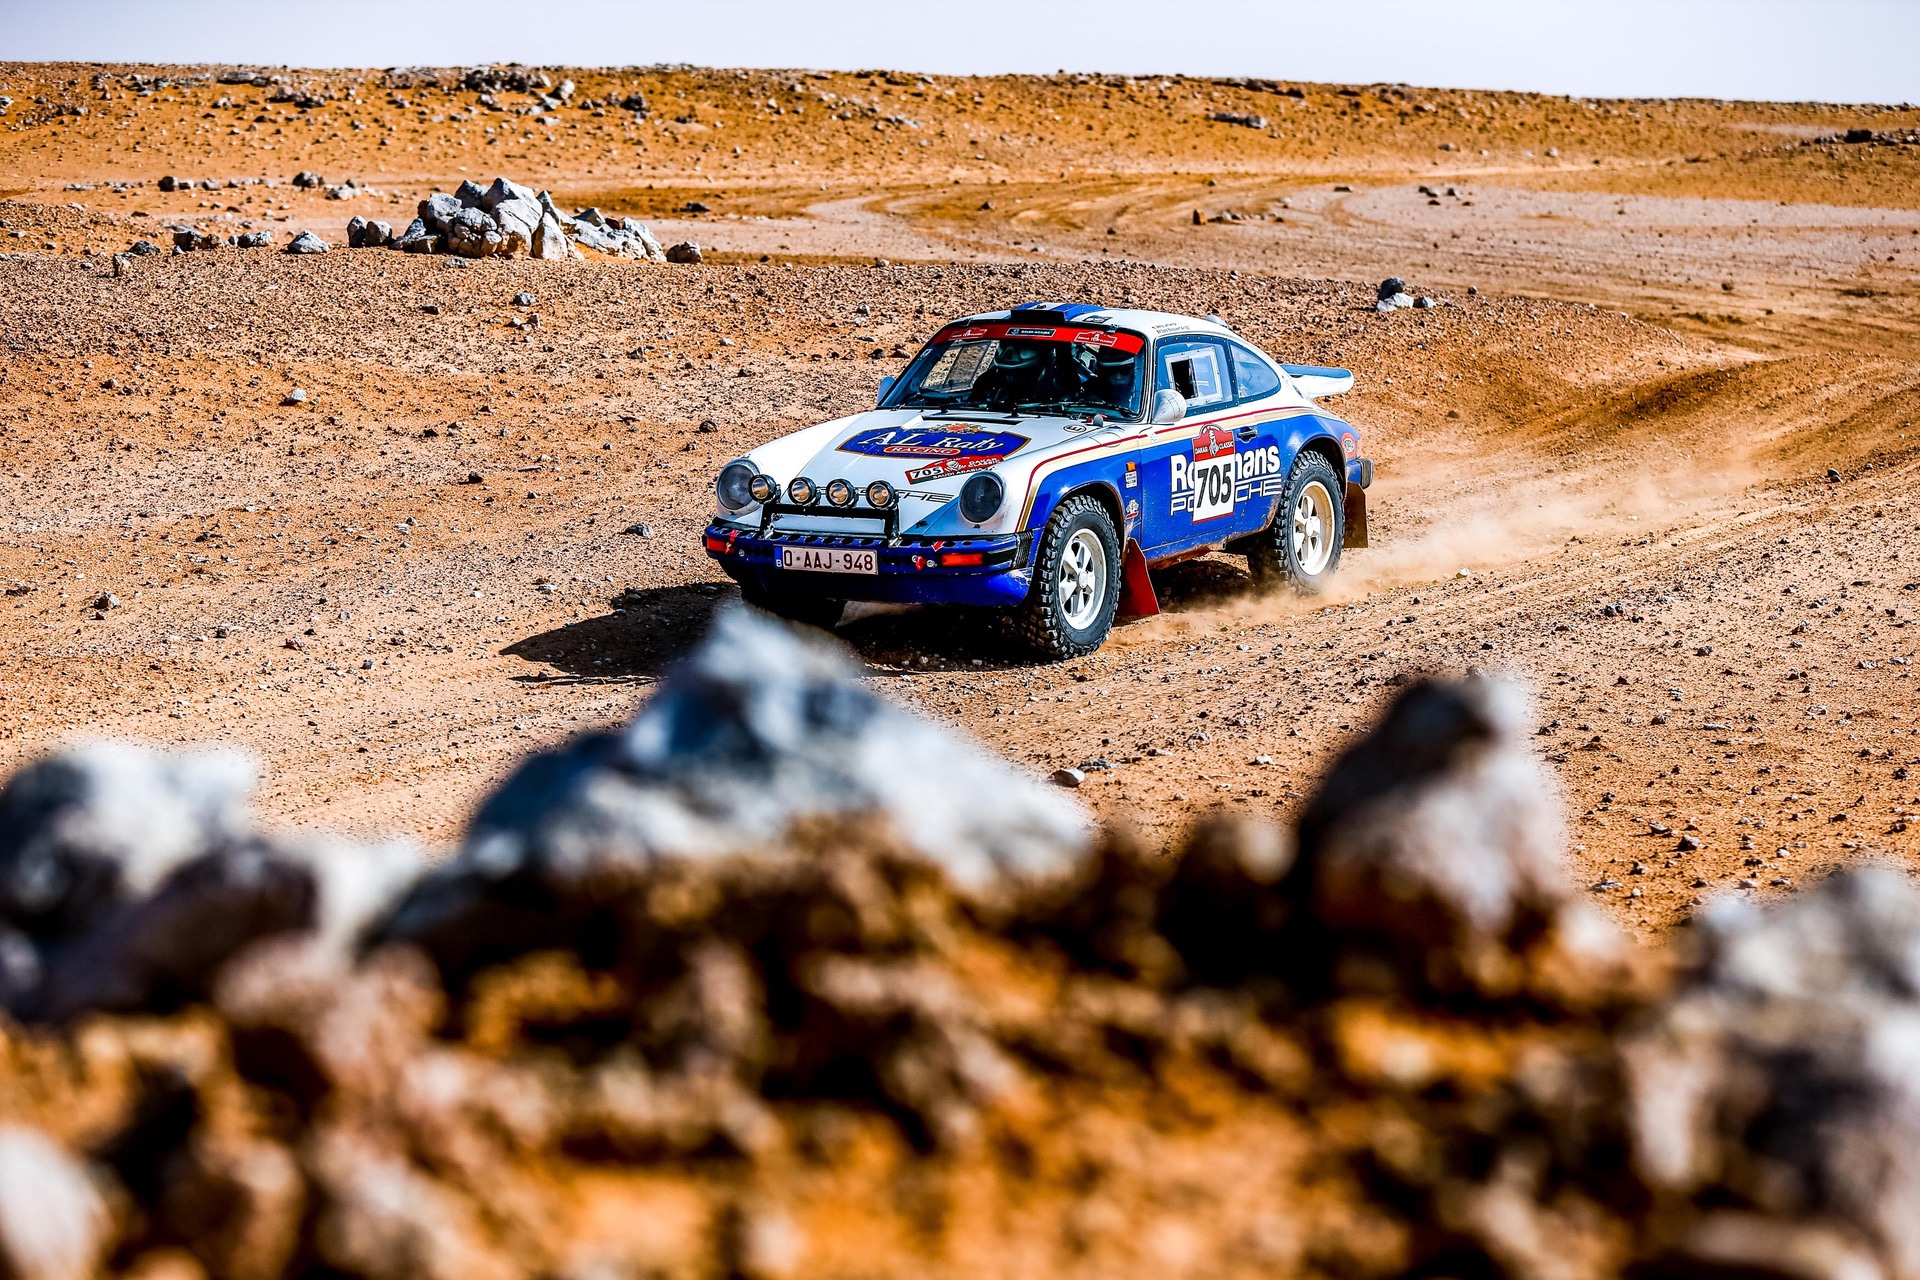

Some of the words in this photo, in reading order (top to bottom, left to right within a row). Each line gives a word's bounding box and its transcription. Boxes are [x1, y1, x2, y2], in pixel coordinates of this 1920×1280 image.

[858, 431, 925, 446] AL
[891, 446, 956, 454] RACING
[1195, 446, 1208, 455] DAKAR
[1219, 441, 1234, 450] CLASSIC
[912, 467, 942, 479] 705
[1197, 463, 1231, 508] 705
